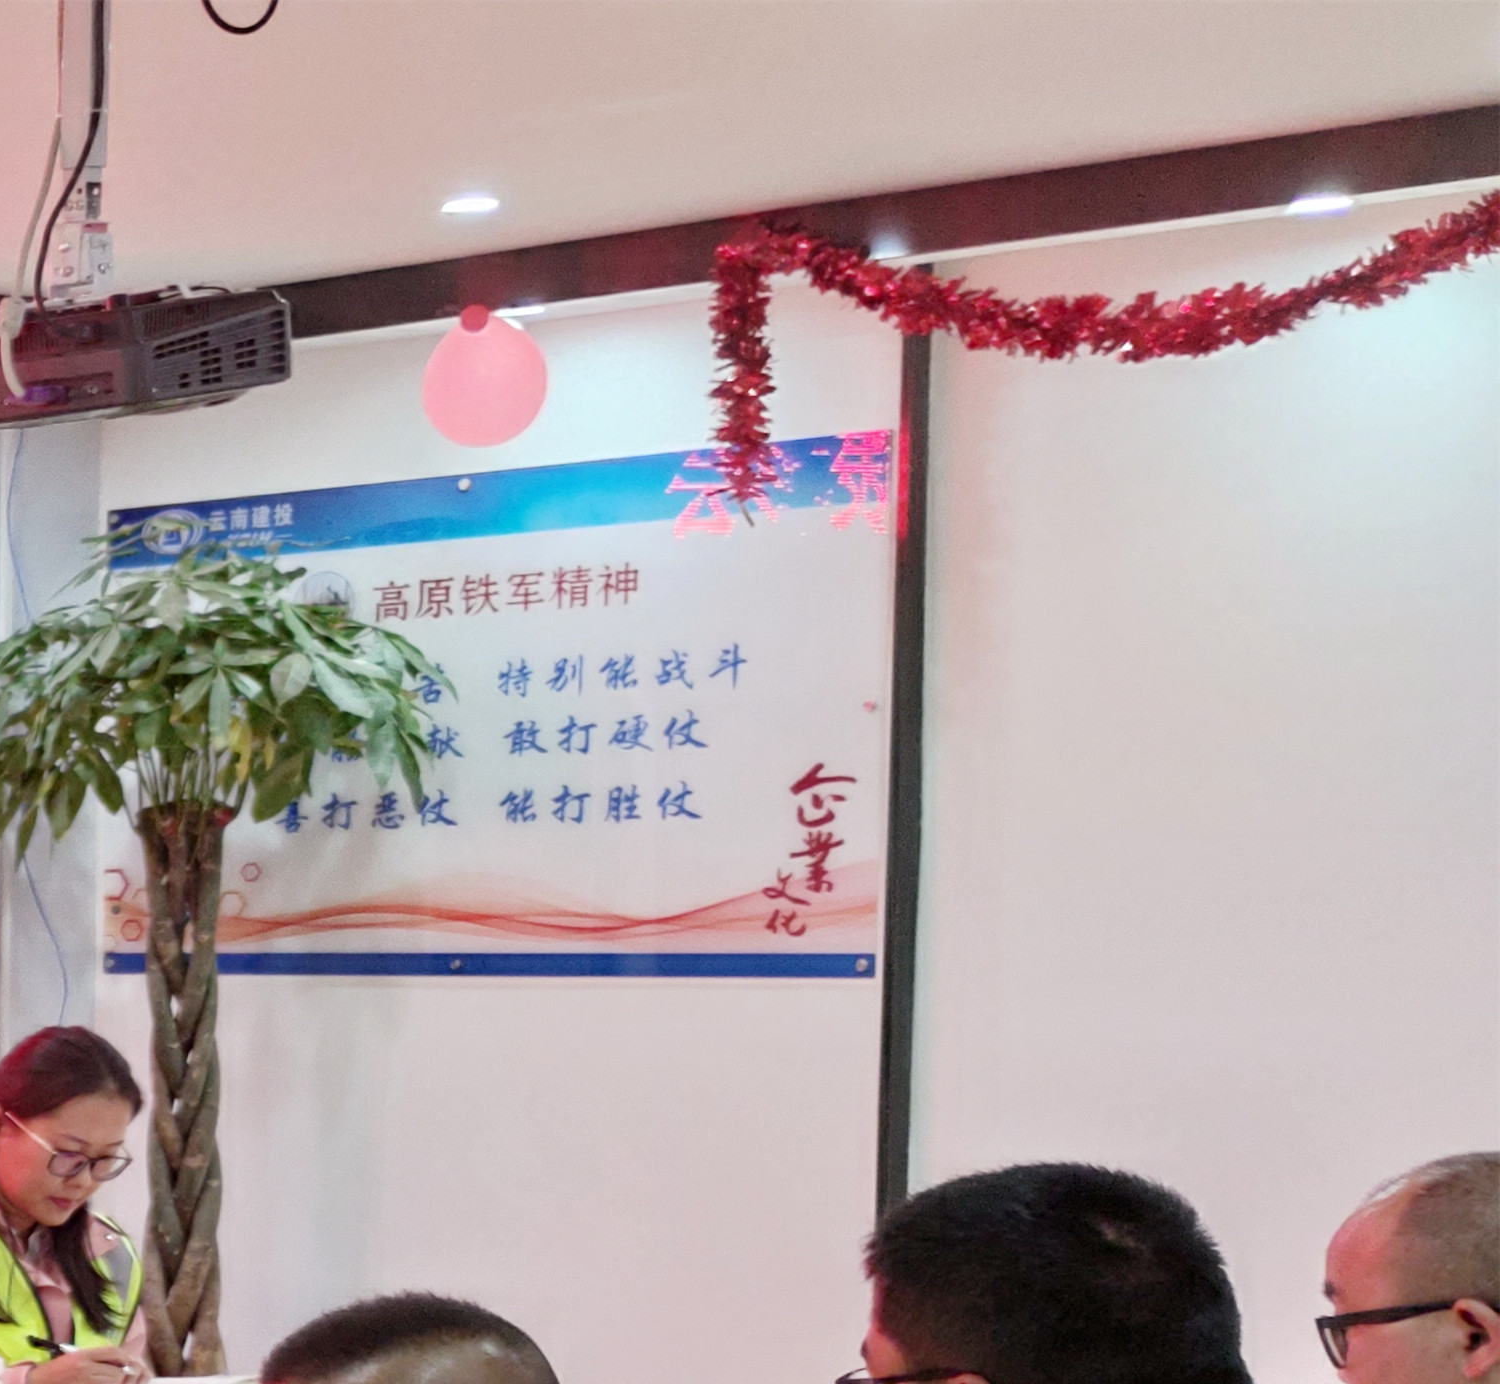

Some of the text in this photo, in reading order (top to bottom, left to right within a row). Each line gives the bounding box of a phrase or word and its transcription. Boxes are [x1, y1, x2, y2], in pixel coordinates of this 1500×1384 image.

[208, 502, 295, 532] 云南建投
[373, 562, 639, 623] 高原铁军精神
[497, 641, 747, 698] 特别能战斗
[503, 708, 708, 757] 敢打硬仗
[499, 780, 702, 824] 能打胜仗
